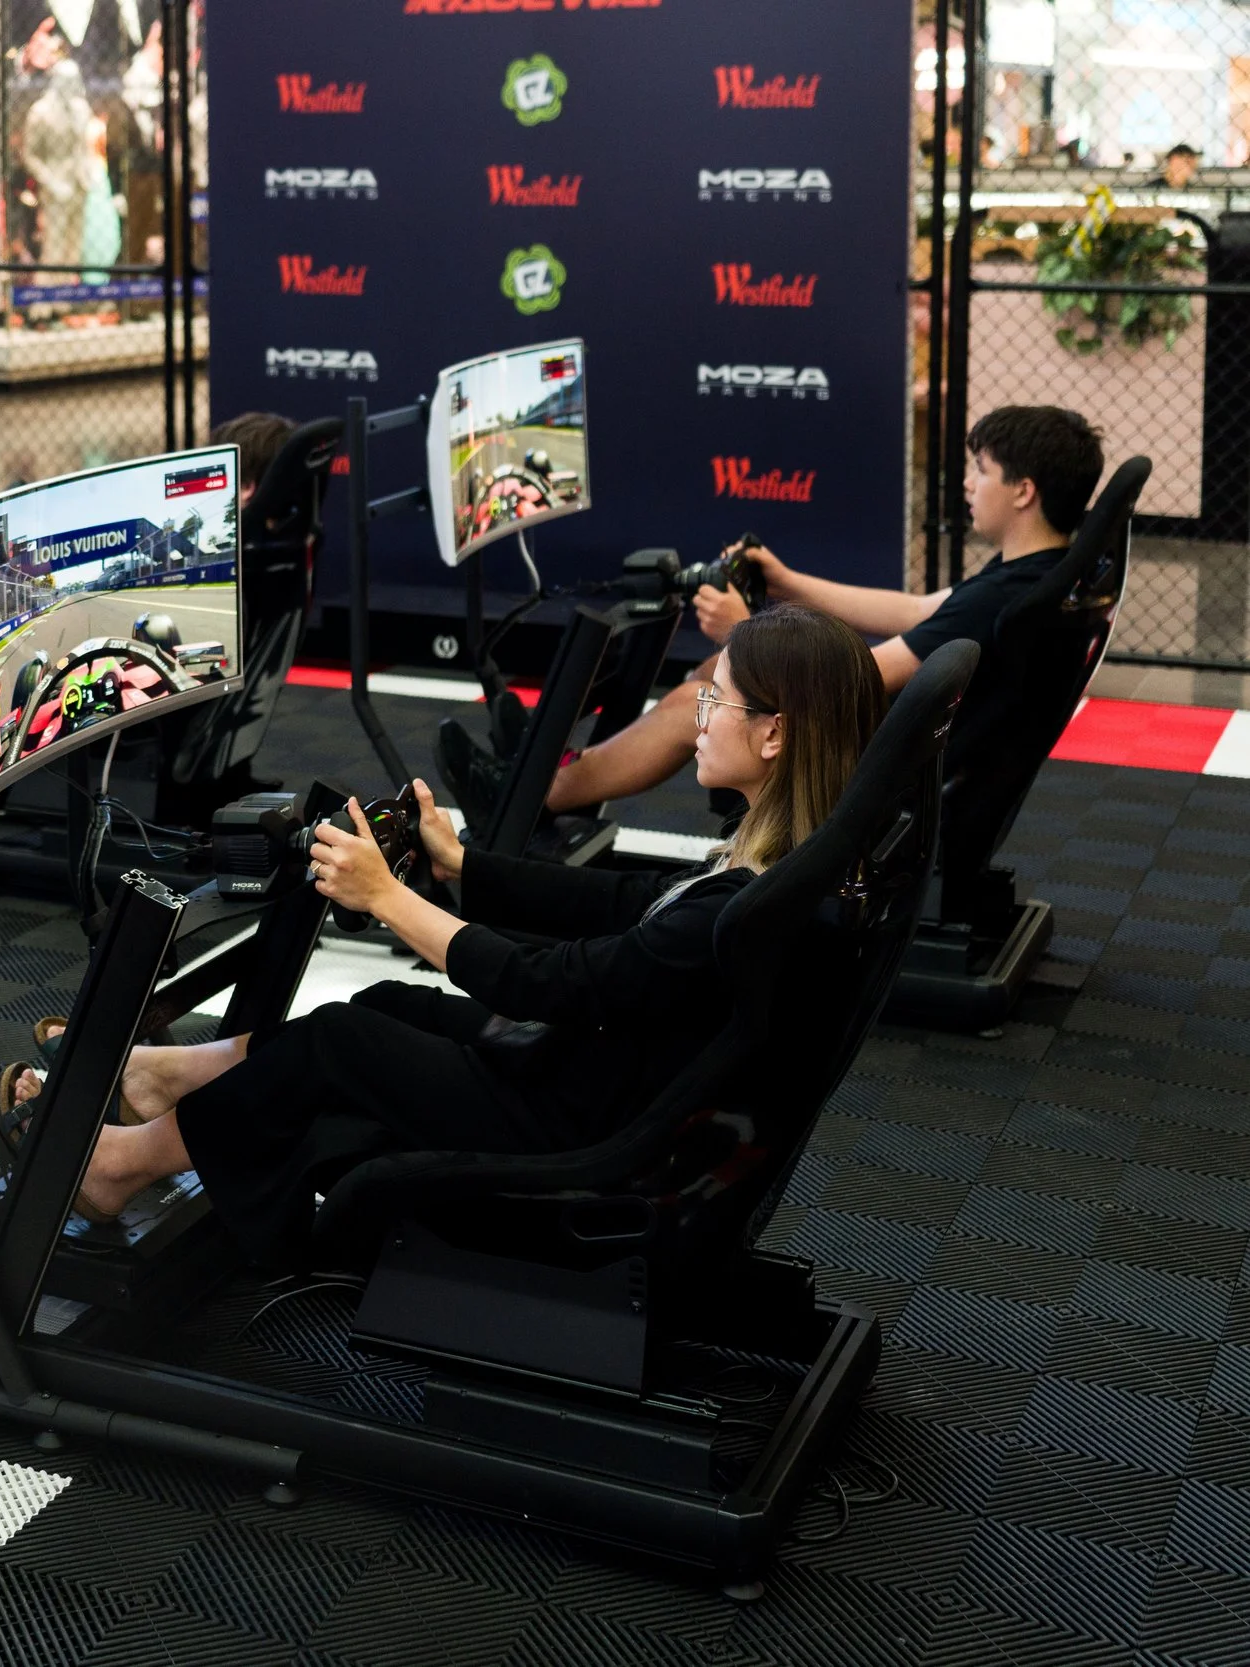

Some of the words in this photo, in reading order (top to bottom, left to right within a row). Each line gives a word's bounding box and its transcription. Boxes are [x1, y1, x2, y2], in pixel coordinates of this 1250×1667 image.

[277, 74, 365, 113] Westfield
[714, 65, 820, 108] Westfield
[265, 168, 378, 188] MOZA
[487, 165, 582, 206] Westfield
[699, 168, 831, 189] MOZA
[278, 255, 367, 295] Westfield
[712, 263, 817, 307] Westfield
[266, 347, 378, 369] MOZA
[698, 364, 829, 387] MOZA
[711, 456, 816, 502] Westfield
[33, 540, 71, 565] LOUIS
[73, 528, 127, 555] VUITTON
